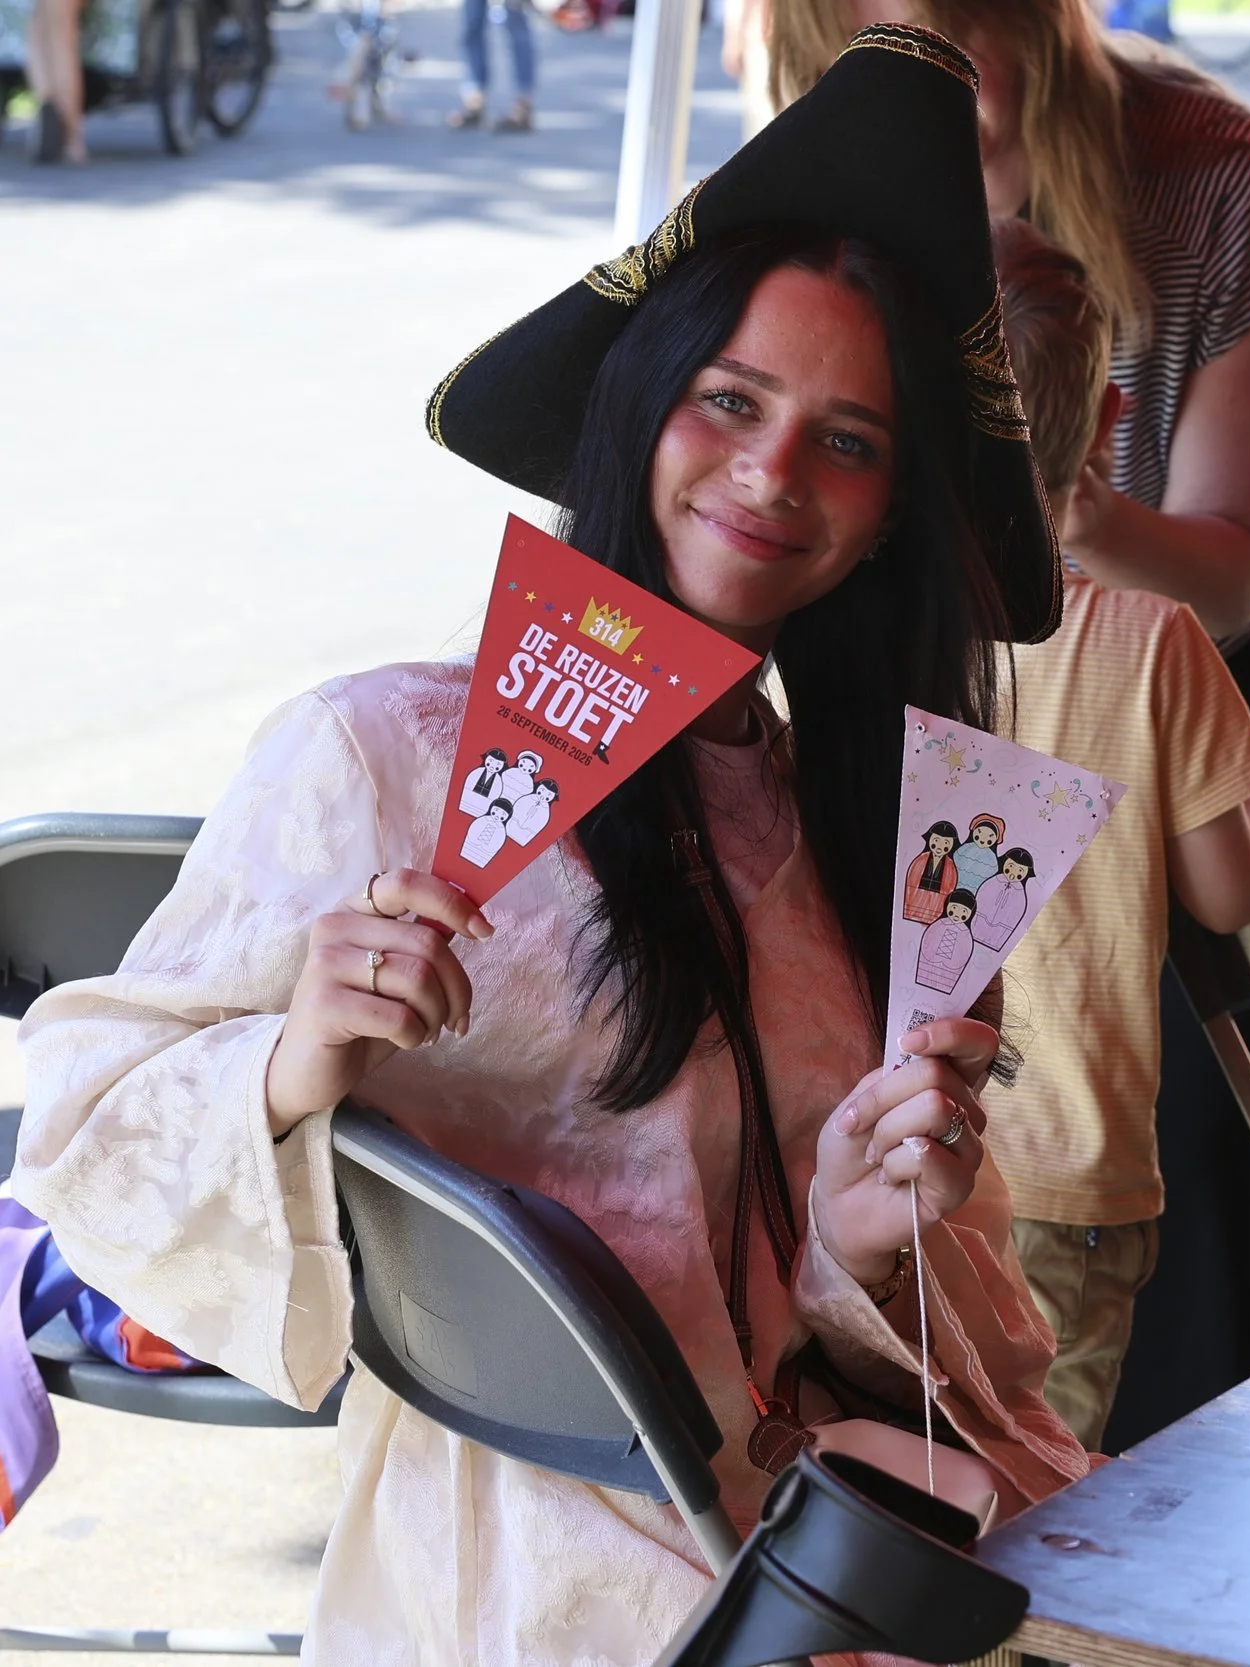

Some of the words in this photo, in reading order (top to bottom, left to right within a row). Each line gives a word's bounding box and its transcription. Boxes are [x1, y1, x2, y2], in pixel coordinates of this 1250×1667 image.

[519, 623, 559, 661] DE
[554, 643, 650, 714] REUZEN
[589, 616, 624, 647] 314
[496, 652, 635, 746] STOET
[497, 705, 511, 718] 26
[510, 712, 569, 753] SEPTEMBER
[568, 746, 593, 767] 2026
